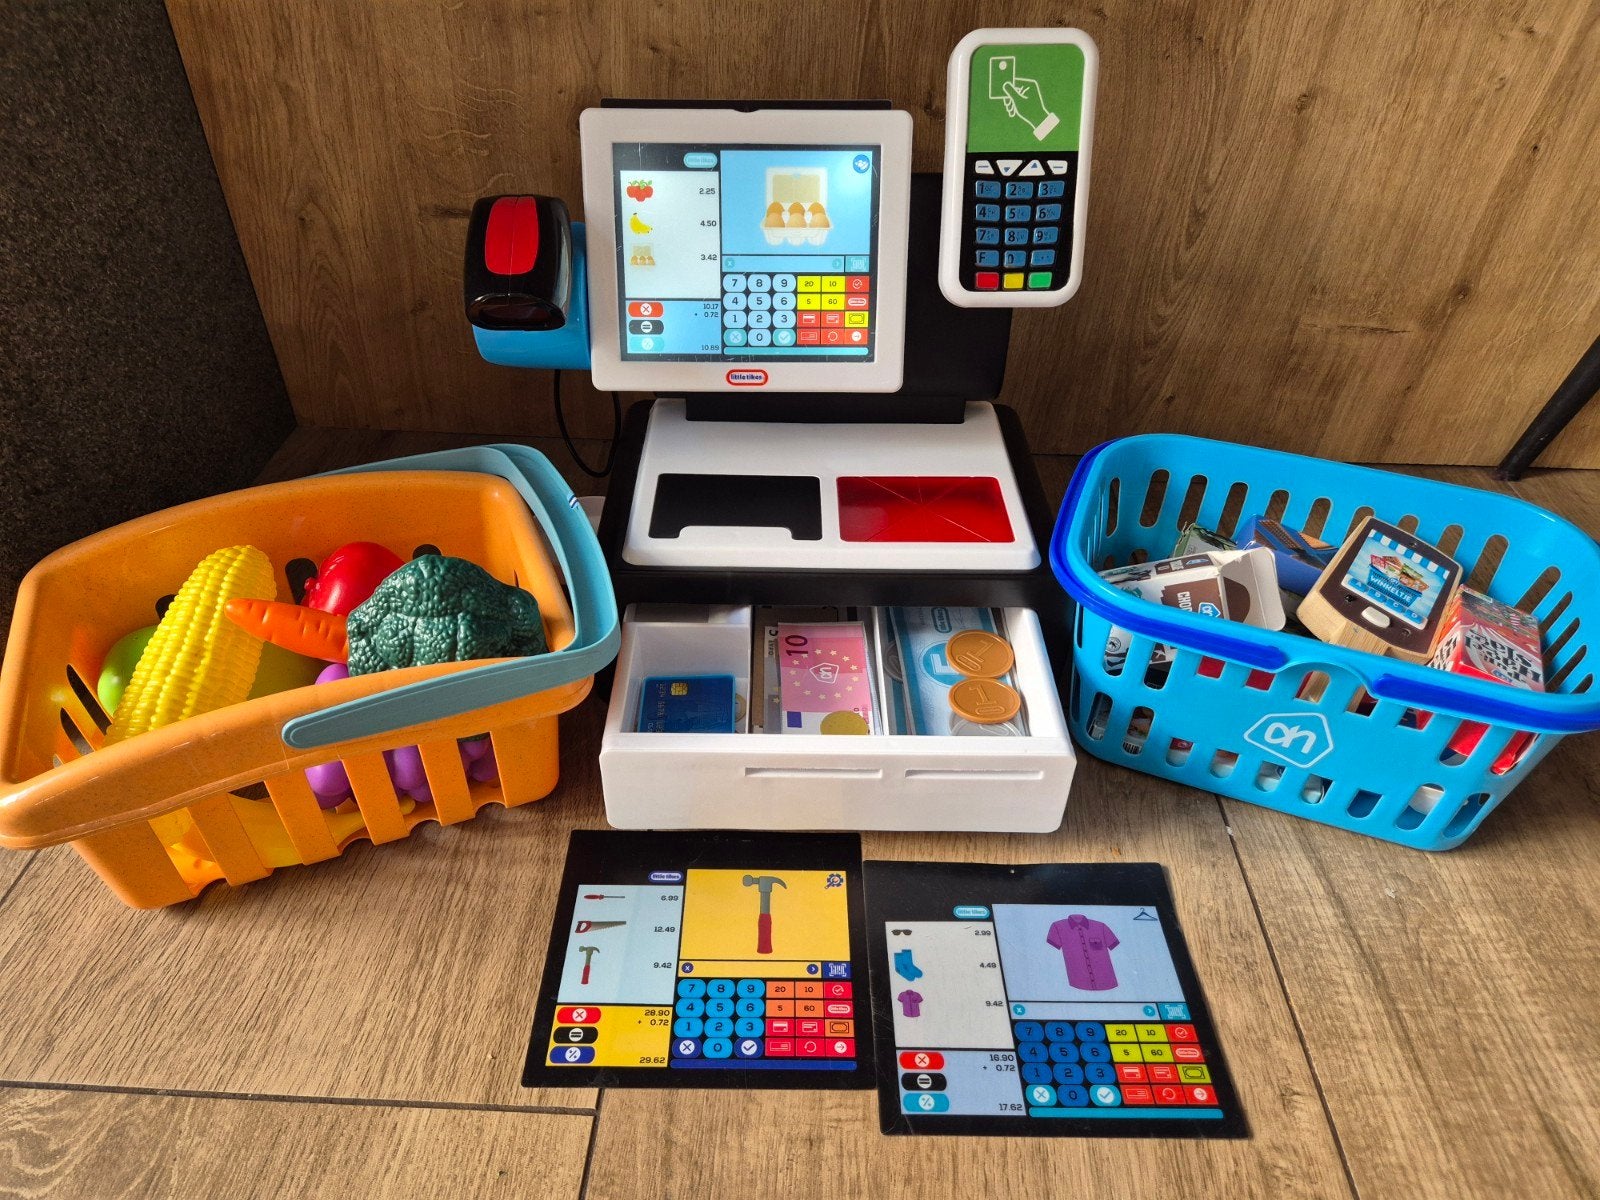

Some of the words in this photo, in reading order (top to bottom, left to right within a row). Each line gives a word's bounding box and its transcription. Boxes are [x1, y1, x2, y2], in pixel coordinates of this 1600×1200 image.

[980, 183, 984, 194] 1
[1010, 184, 1017, 195] 2
[1042, 184, 1048, 195] 3
[979, 207, 986, 217] 4
[1009, 208, 1015, 218] 5
[1040, 208, 1046, 218] 6
[980, 230, 986, 240] 7
[1008, 231, 1016, 241] 8
[1037, 231, 1043, 241] 9
[979, 252, 985, 263] F
[1008, 254, 1014, 264] 0
[732, 279, 737, 287] 7
[756, 279, 762, 287] 8
[781, 279, 787, 287] 9
[732, 297, 738, 305] 4
[757, 297, 762, 305] 5
[781, 297, 787, 305] 6
[733, 315, 737, 323] 1
[757, 315, 762, 323] 2
[781, 315, 787, 323] 3
[756, 333, 763, 341] 0
[1370, 575, 1412, 602] WINKELTJE
[785, 635, 808, 656] 10
[689, 984, 696, 992] 7
[717, 984, 725, 993] 8
[747, 985, 754, 993] 9
[686, 1003, 694, 1011] 4
[717, 1003, 724, 1012] 5
[746, 1003, 754, 1012] 6
[686, 1022, 691, 1031] 1
[715, 1022, 723, 1031] 2
[746, 1022, 753, 1031] 3
[1025, 1026, 1033, 1036] 7
[1056, 1027, 1064, 1036] 8
[1086, 1028, 1096, 1036] 9
[713, 1043, 722, 1052] 0
[1030, 1047, 1037, 1057] 4
[1059, 1047, 1069, 1056] 5
[1091, 1048, 1100, 1057] 6
[639, 1057, 667, 1065] 29.62
[990, 1054, 1015, 1062] 16.90
[1034, 1068, 1040, 1079] 1
[1064, 1067, 1073, 1077] 2
[1096, 1066, 1104, 1079] 3
[1069, 1090, 1077, 1100] 0
[999, 1103, 1024, 1111] 17.62
